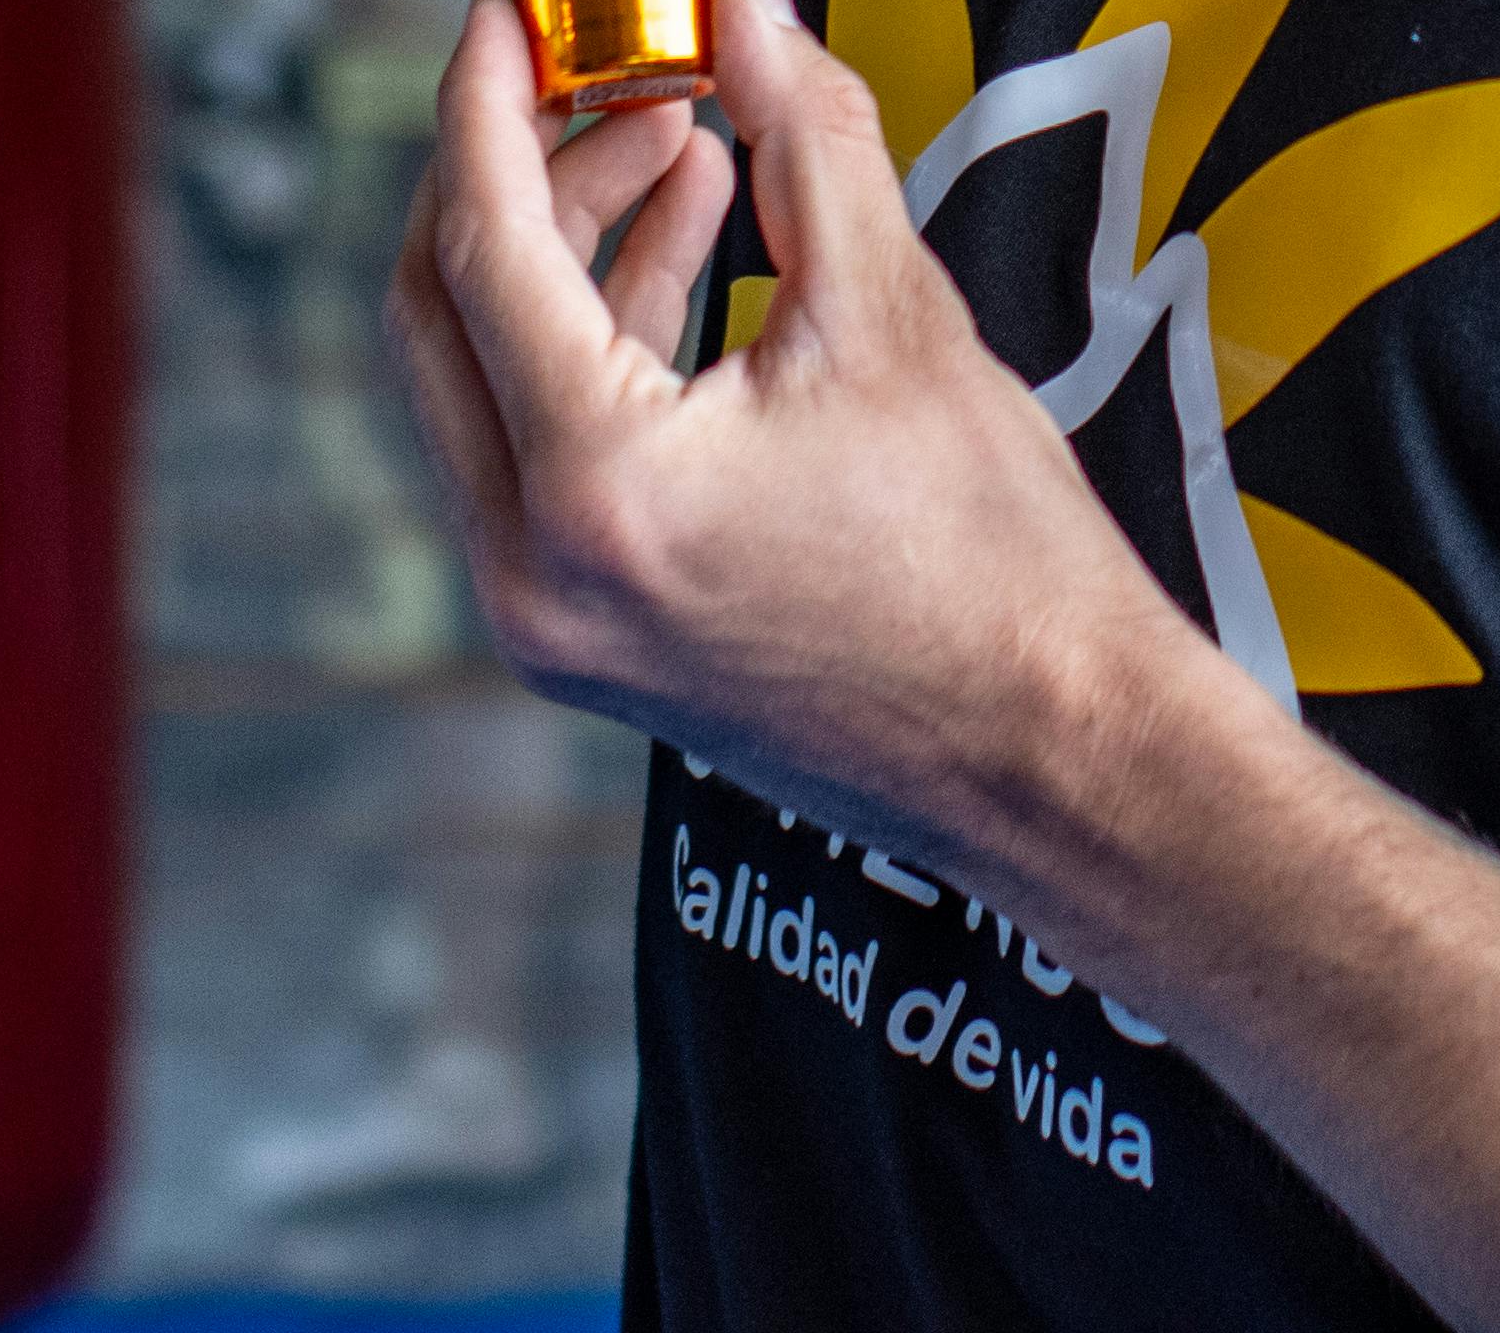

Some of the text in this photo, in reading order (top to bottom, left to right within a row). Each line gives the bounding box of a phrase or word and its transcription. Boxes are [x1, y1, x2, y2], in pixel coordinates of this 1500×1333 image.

[672, 823, 878, 1027] Calidad
[886, 980, 1002, 1091] de
[1010, 1047, 1154, 1189] vida
